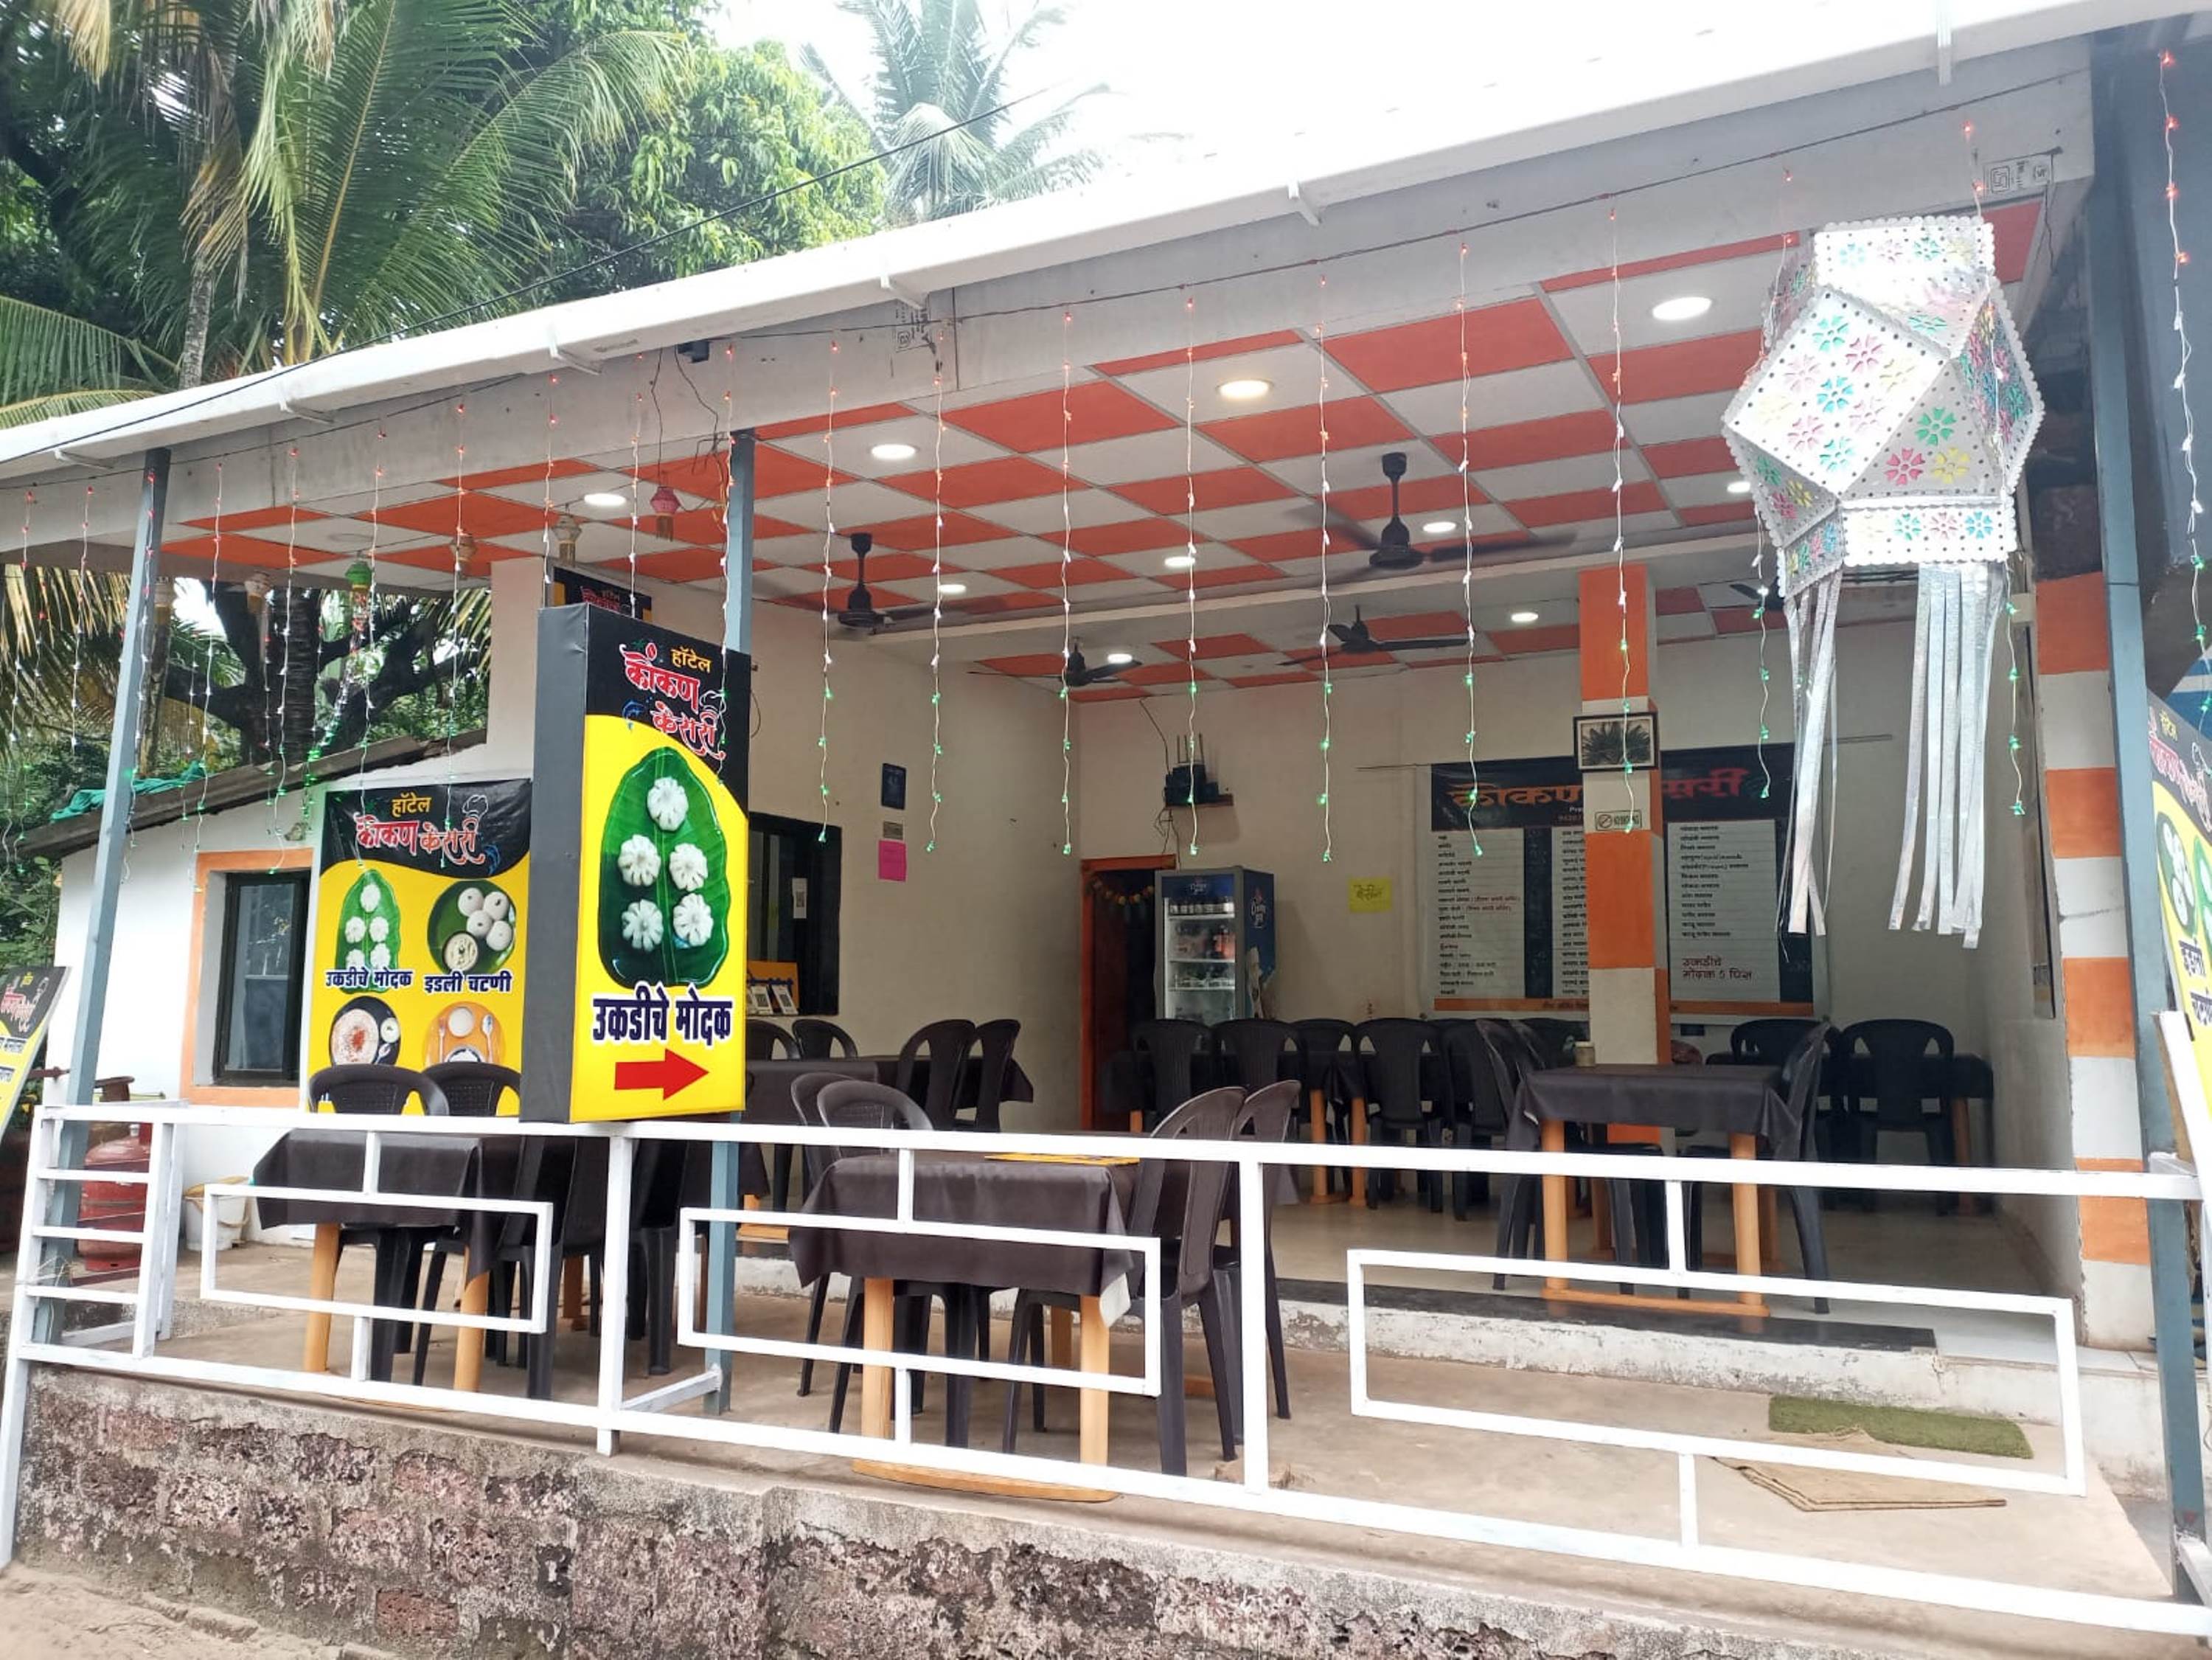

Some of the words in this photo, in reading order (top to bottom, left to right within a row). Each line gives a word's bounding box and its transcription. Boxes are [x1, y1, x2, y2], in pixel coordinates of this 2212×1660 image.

[670, 646, 712, 673] हॉटेल
[391, 791, 431, 817] हॉटेल
[326, 967, 369, 987] उकडीचे
[374, 968, 413, 989] मोदक
[425, 971, 463, 991] इडली
[467, 971, 512, 992] चटणी
[593, 985, 670, 1041] उकडीचे
[675, 987, 733, 1046] मोदक
